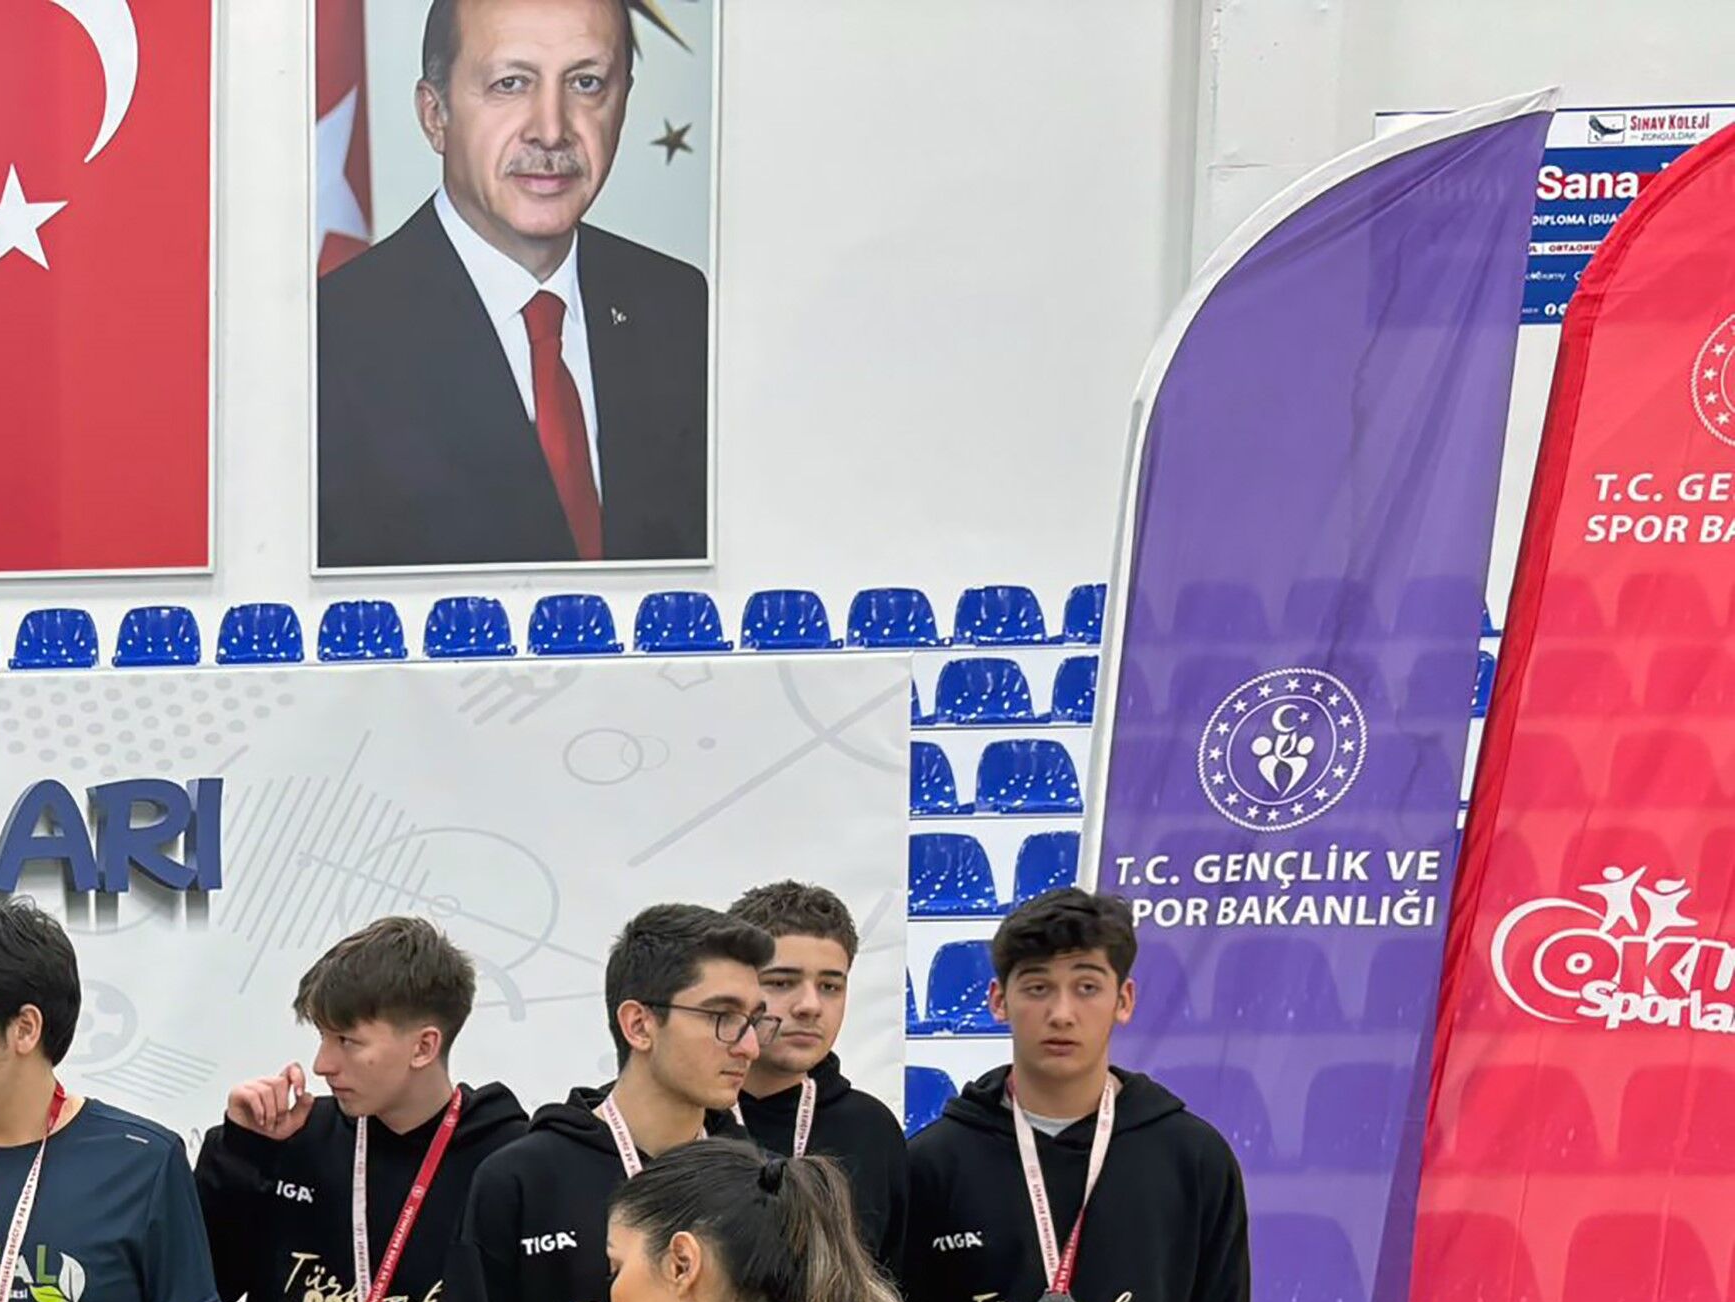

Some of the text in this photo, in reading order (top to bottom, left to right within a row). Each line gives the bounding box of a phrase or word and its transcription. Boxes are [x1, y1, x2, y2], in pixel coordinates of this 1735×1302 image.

[1536, 166, 1639, 200] Sana
[1594, 472, 1735, 502] T.C. GE
[1584, 514, 1689, 543] SPOR
[1115, 843, 1441, 889] T.C. GENÇLİK VE
[1131, 888, 1436, 928] POR BAKANLIĞI
[1575, 979, 1735, 1033] Sporla
